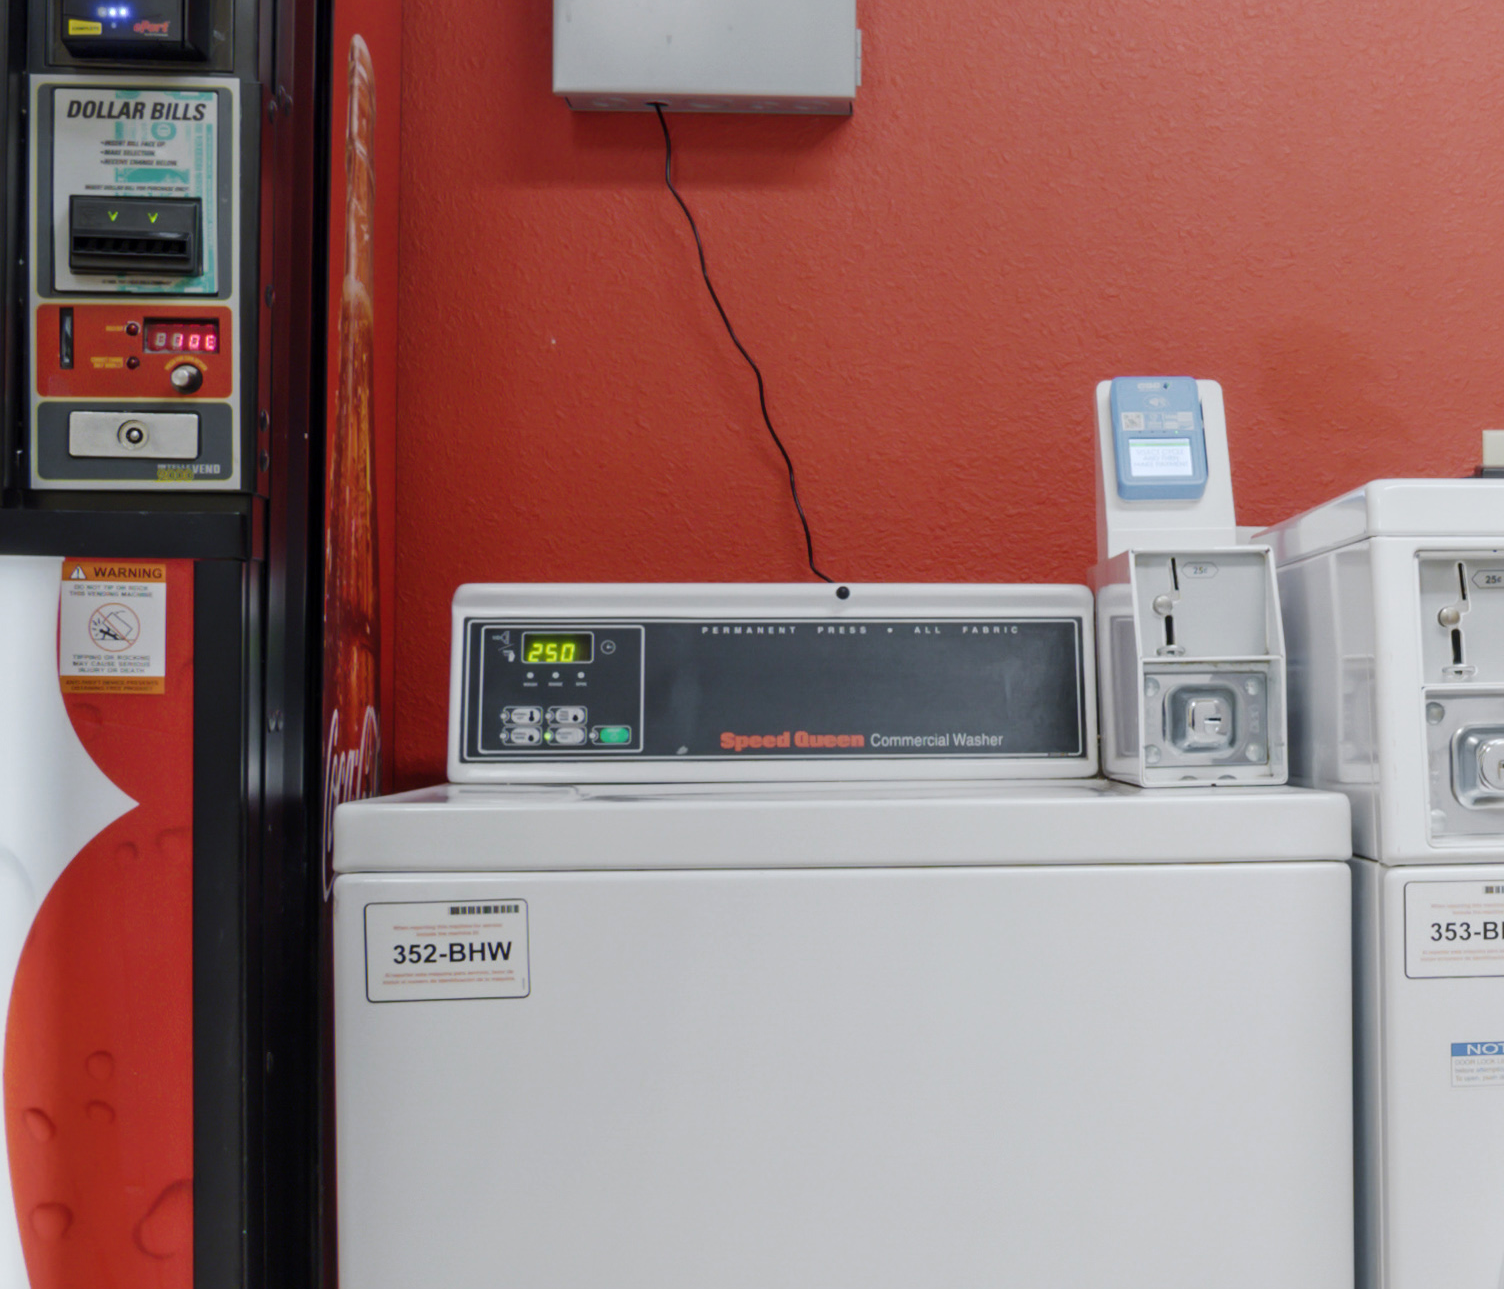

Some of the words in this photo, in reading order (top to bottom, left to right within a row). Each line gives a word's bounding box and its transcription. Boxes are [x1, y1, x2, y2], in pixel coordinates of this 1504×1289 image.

[67, 100, 146, 120] DOLLAR
[150, 102, 207, 121] BILLS
[93, 567, 162, 579] WARNING
[1485, 575, 1502, 584] 25¢
[701, 626, 797, 635] PERMANENT
[817, 626, 868, 635] PRESS
[914, 626, 942, 634] ALL
[962, 626, 1019, 634] FABRIC
[528, 643, 576, 663] 250
[720, 731, 791, 752] Speed
[794, 730, 865, 748] Queen
[870, 732, 950, 747] Commercial
[953, 732, 1004, 748] Washer
[393, 941, 512, 965] 352-BHW
